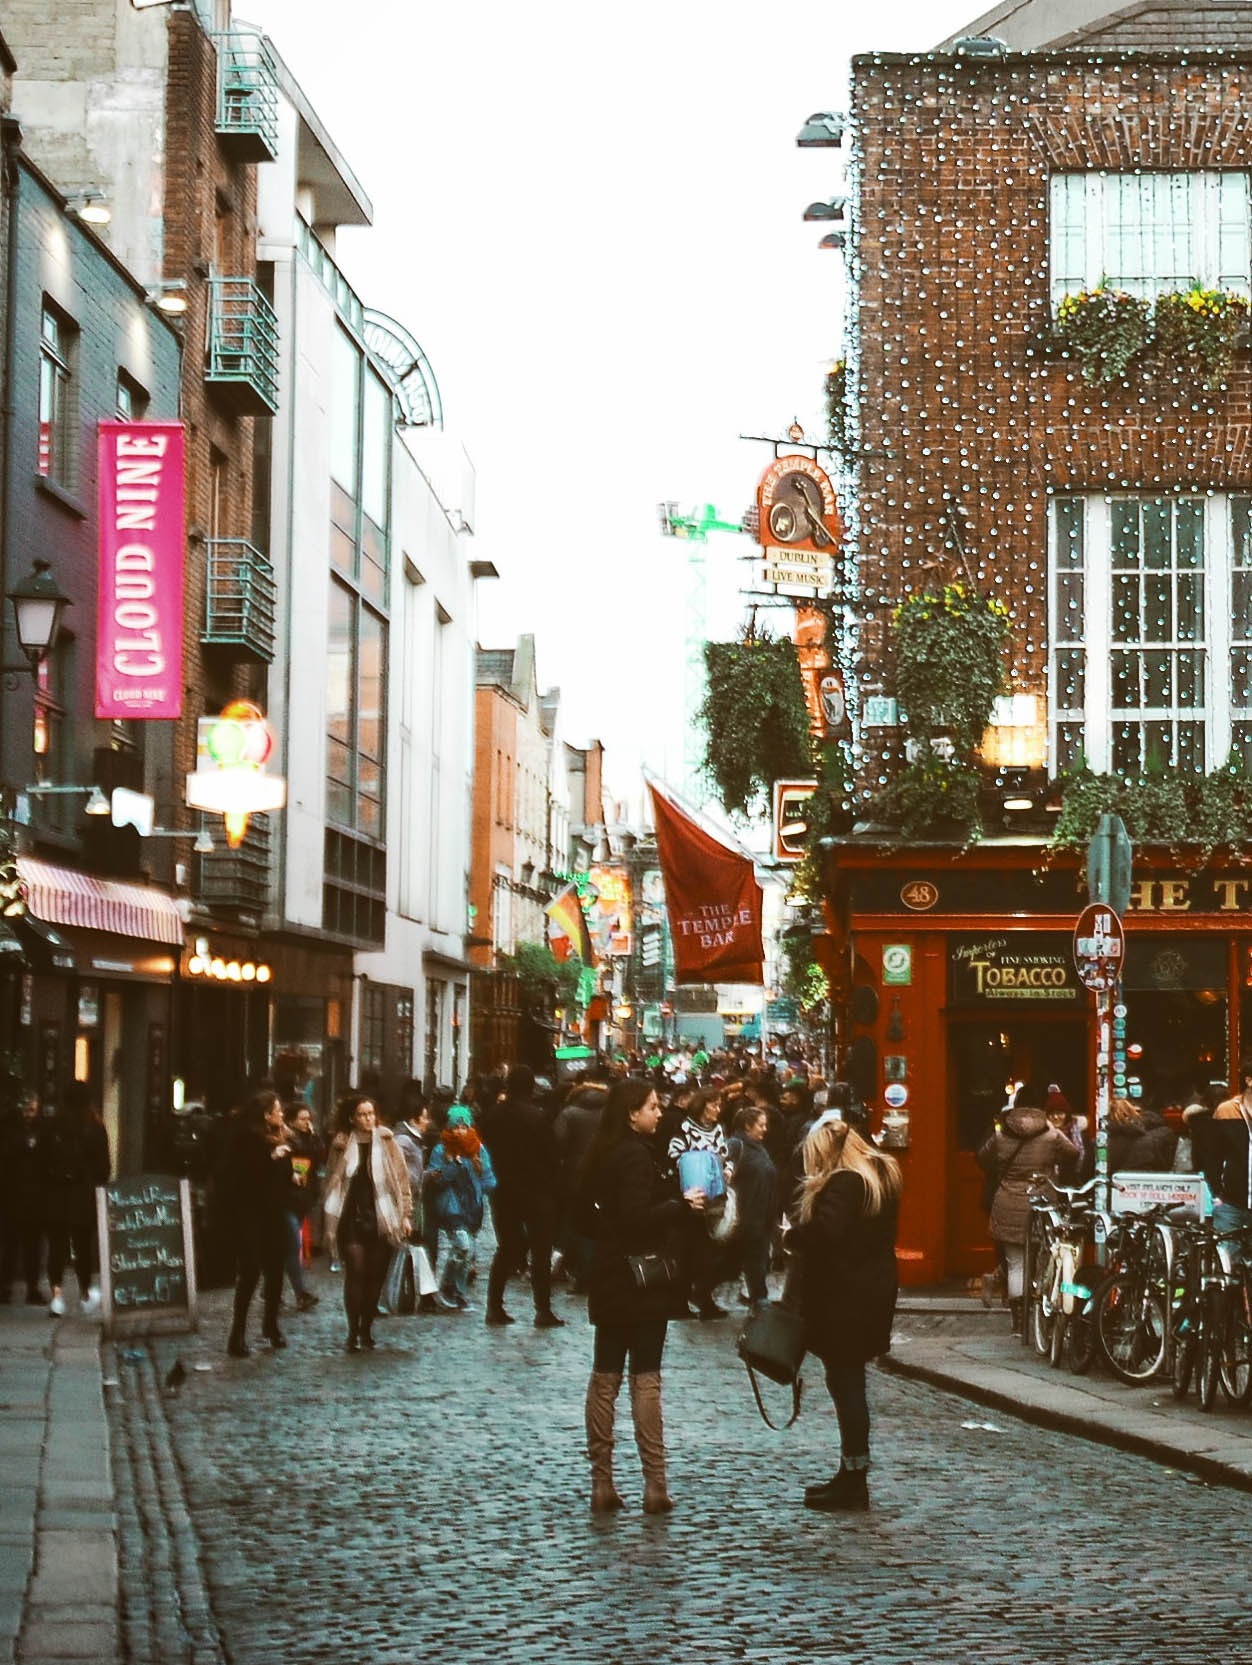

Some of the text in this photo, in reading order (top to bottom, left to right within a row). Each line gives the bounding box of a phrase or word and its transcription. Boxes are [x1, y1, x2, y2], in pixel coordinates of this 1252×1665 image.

[116, 434, 167, 531] NINE
[762, 459, 835, 516] THE TEMPLE BAR
[779, 550, 819, 563] DUBLIN
[771, 570, 825, 586] LIVE MUSIC
[114, 542, 164, 677] CLOUD
[907, 886, 931, 903] 48
[699, 904, 731, 917] THE
[680, 909, 752, 936] TEMPLE
[700, 930, 735, 949] BAR
